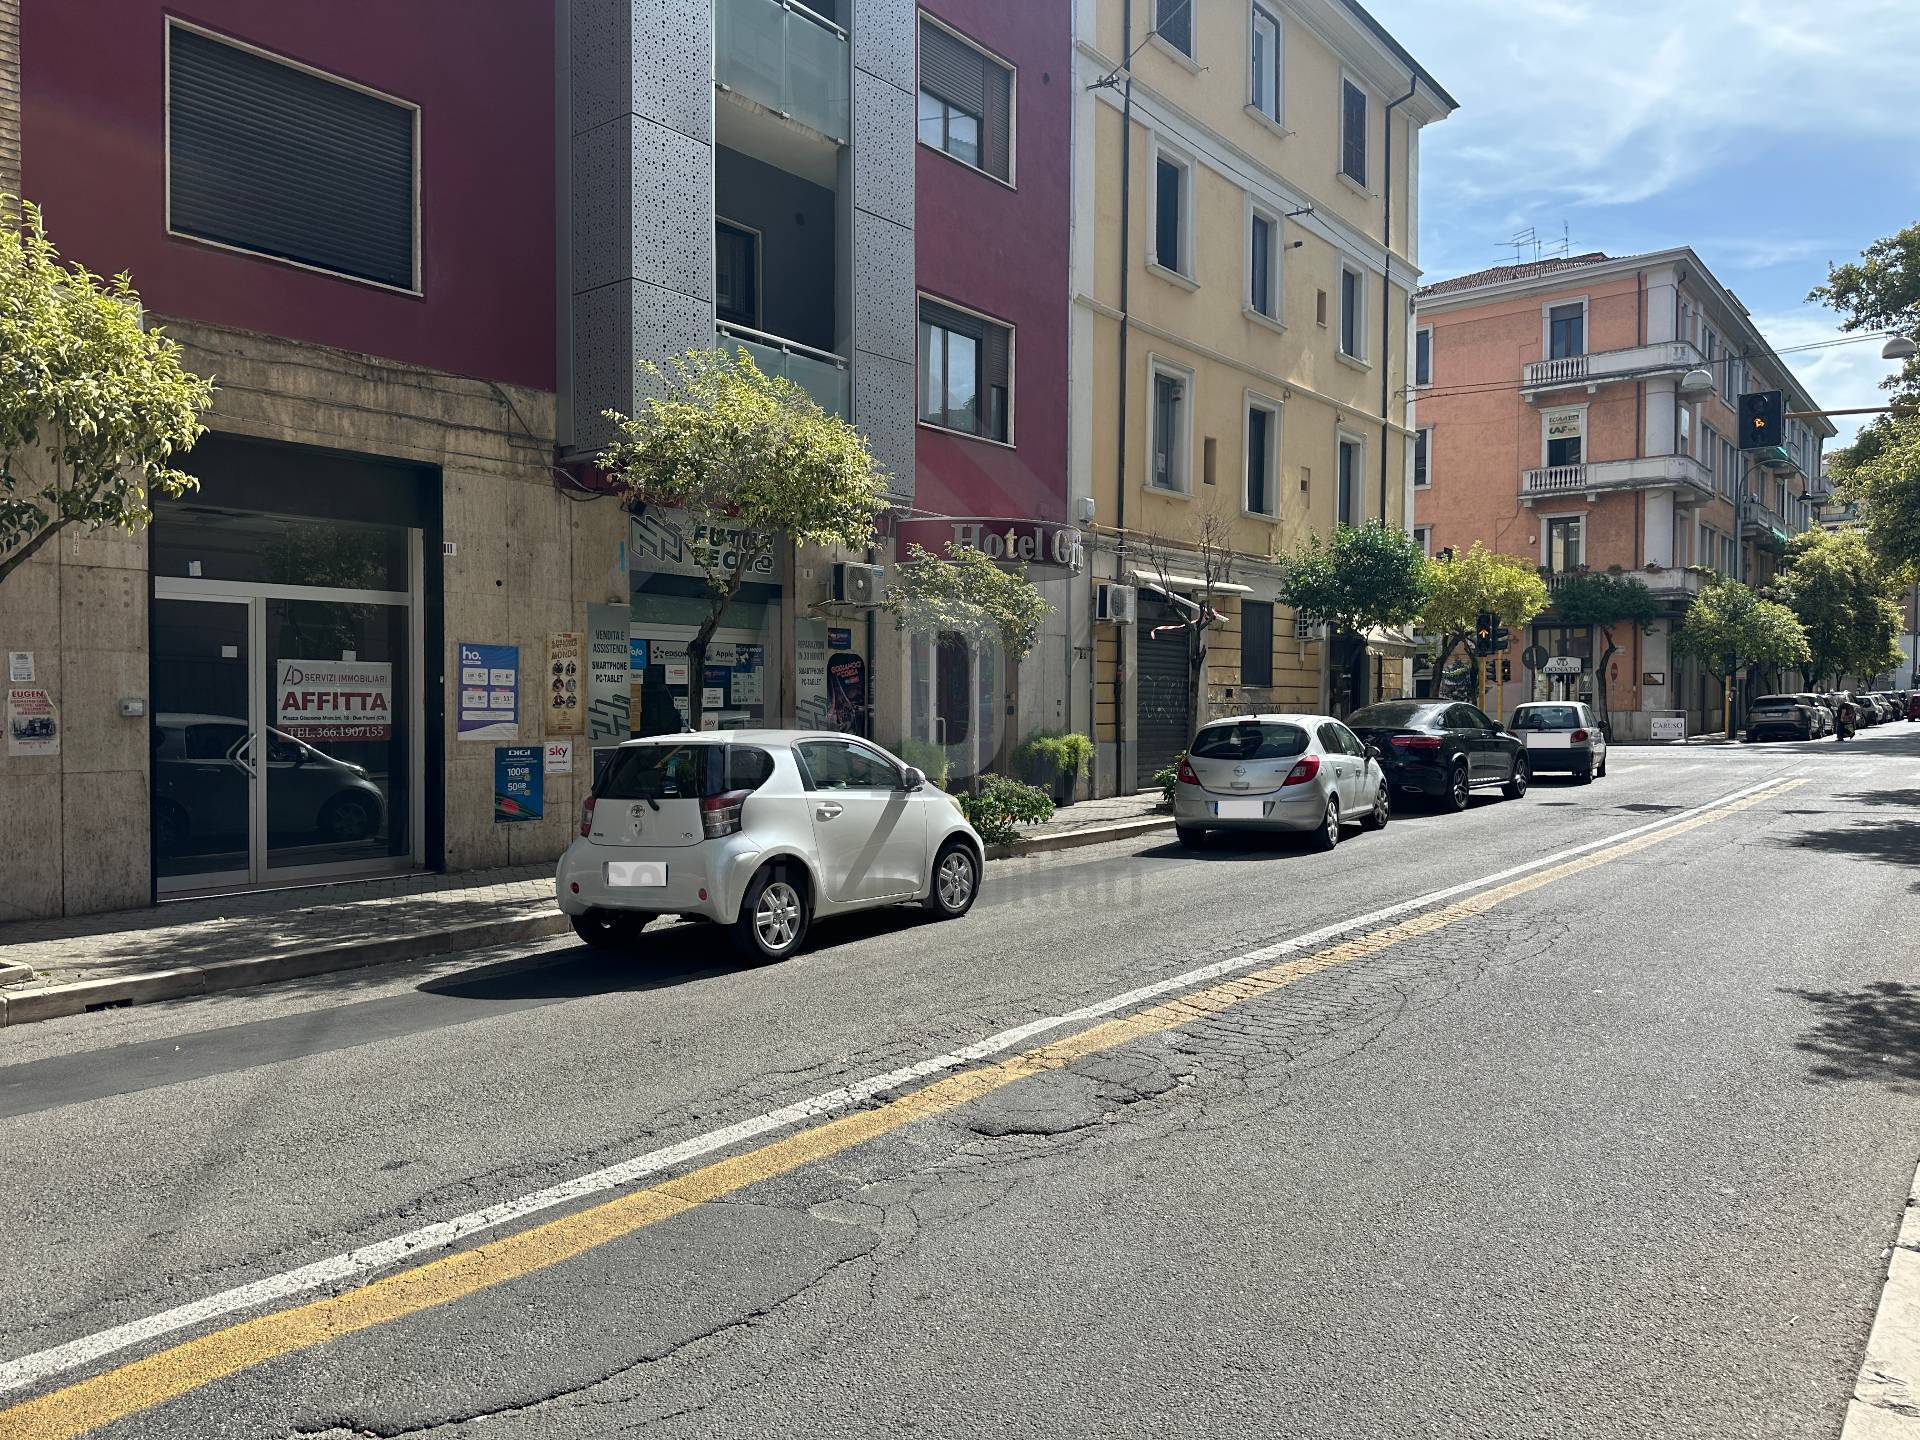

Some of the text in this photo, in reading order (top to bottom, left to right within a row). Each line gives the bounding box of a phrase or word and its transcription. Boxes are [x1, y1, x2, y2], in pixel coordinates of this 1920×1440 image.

[950, 524, 1045, 561] Hotel
[596, 630, 625, 640] VENDITA E
[592, 643, 628, 654] ASSISTENZA
[715, 650, 734, 659] Apple
[592, 660, 628, 670] SMARTPHONE
[304, 673, 336, 682] SERVIZI
[338, 674, 387, 684] IMMOBILIARI
[595, 674, 624, 683] PC-TABLET
[12, 690, 44, 698] EUGEN
[281, 691, 388, 711] AFFITTA
[318, 726, 385, 738] 366.1907155
[549, 747, 569, 758] sky
